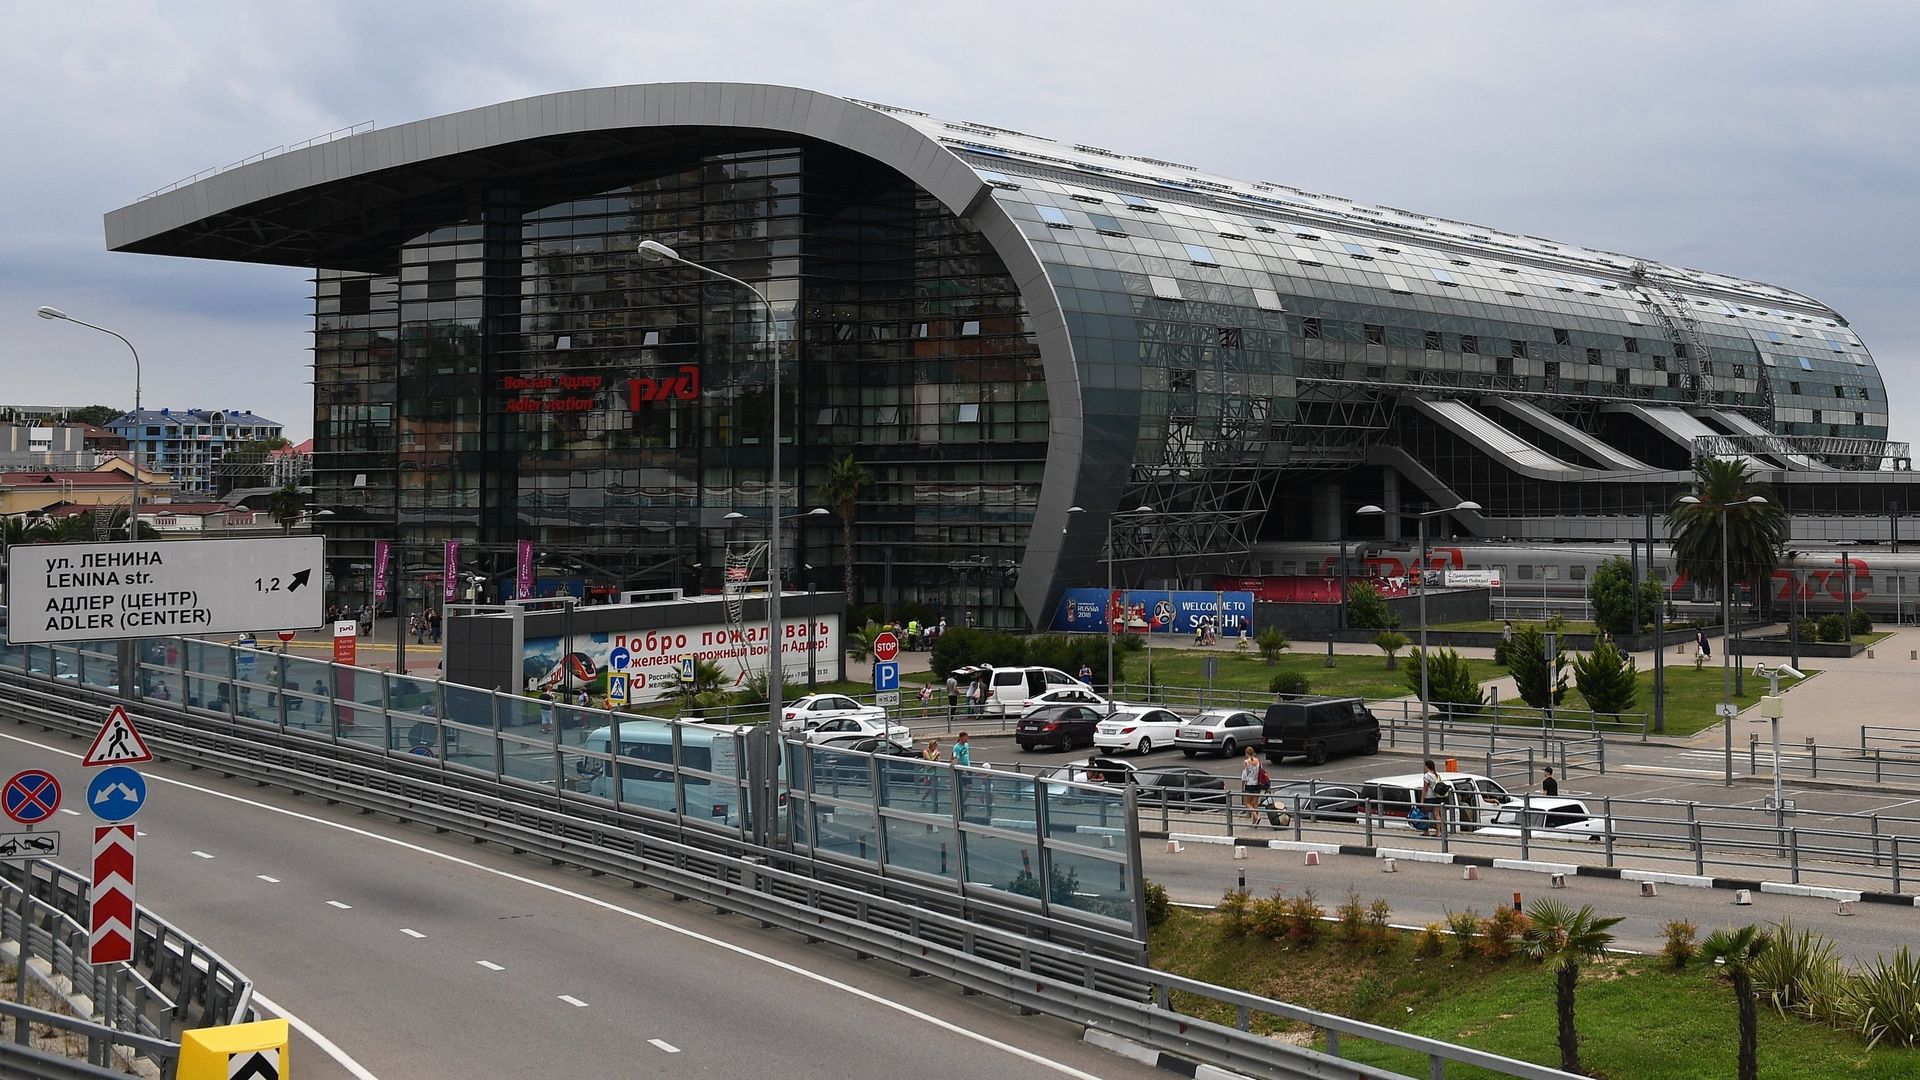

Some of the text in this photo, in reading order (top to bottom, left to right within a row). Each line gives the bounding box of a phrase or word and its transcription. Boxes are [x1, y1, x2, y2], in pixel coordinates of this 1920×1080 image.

[504, 375, 602, 390] Вокзал Адлер
[508, 397, 541, 412] Adler
[46, 551, 163, 573] ул. ЛЕНИНА
[46, 571, 154, 588] LENINA str.
[254, 577, 280, 594] 1,2
[45, 590, 198, 614] АДЛЕР (ЦЕНТР)
[1233, 601, 1246, 611] TO
[45, 608, 212, 631] ADLER (CENTER)
[615, 622, 829, 655] Добро пожалвать
[877, 642, 896, 652] STOP
[631, 647, 747, 668] железноорожный
[750, 644, 788, 656] вокл
[882, 665, 895, 688] P
